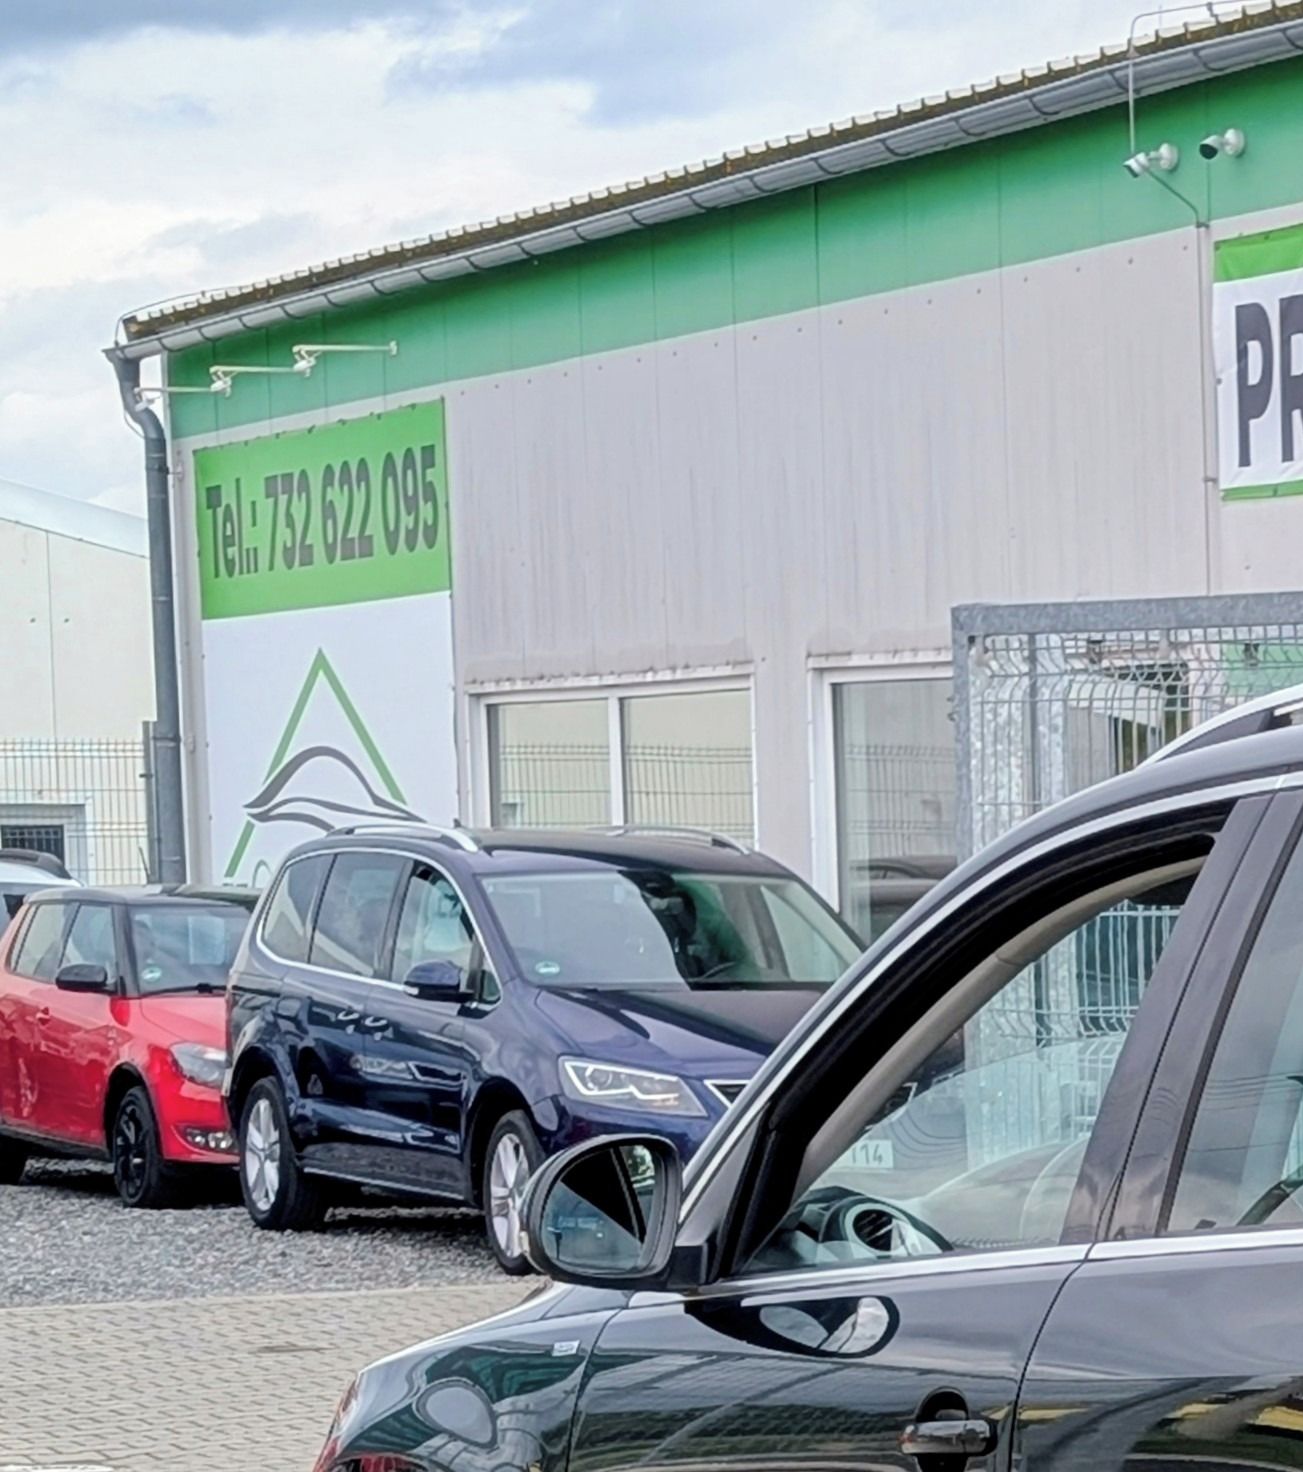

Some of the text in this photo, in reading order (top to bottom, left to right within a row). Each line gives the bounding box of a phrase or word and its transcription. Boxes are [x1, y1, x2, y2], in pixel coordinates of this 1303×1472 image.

[206, 444, 439, 579] Tel.: 732 622 095
